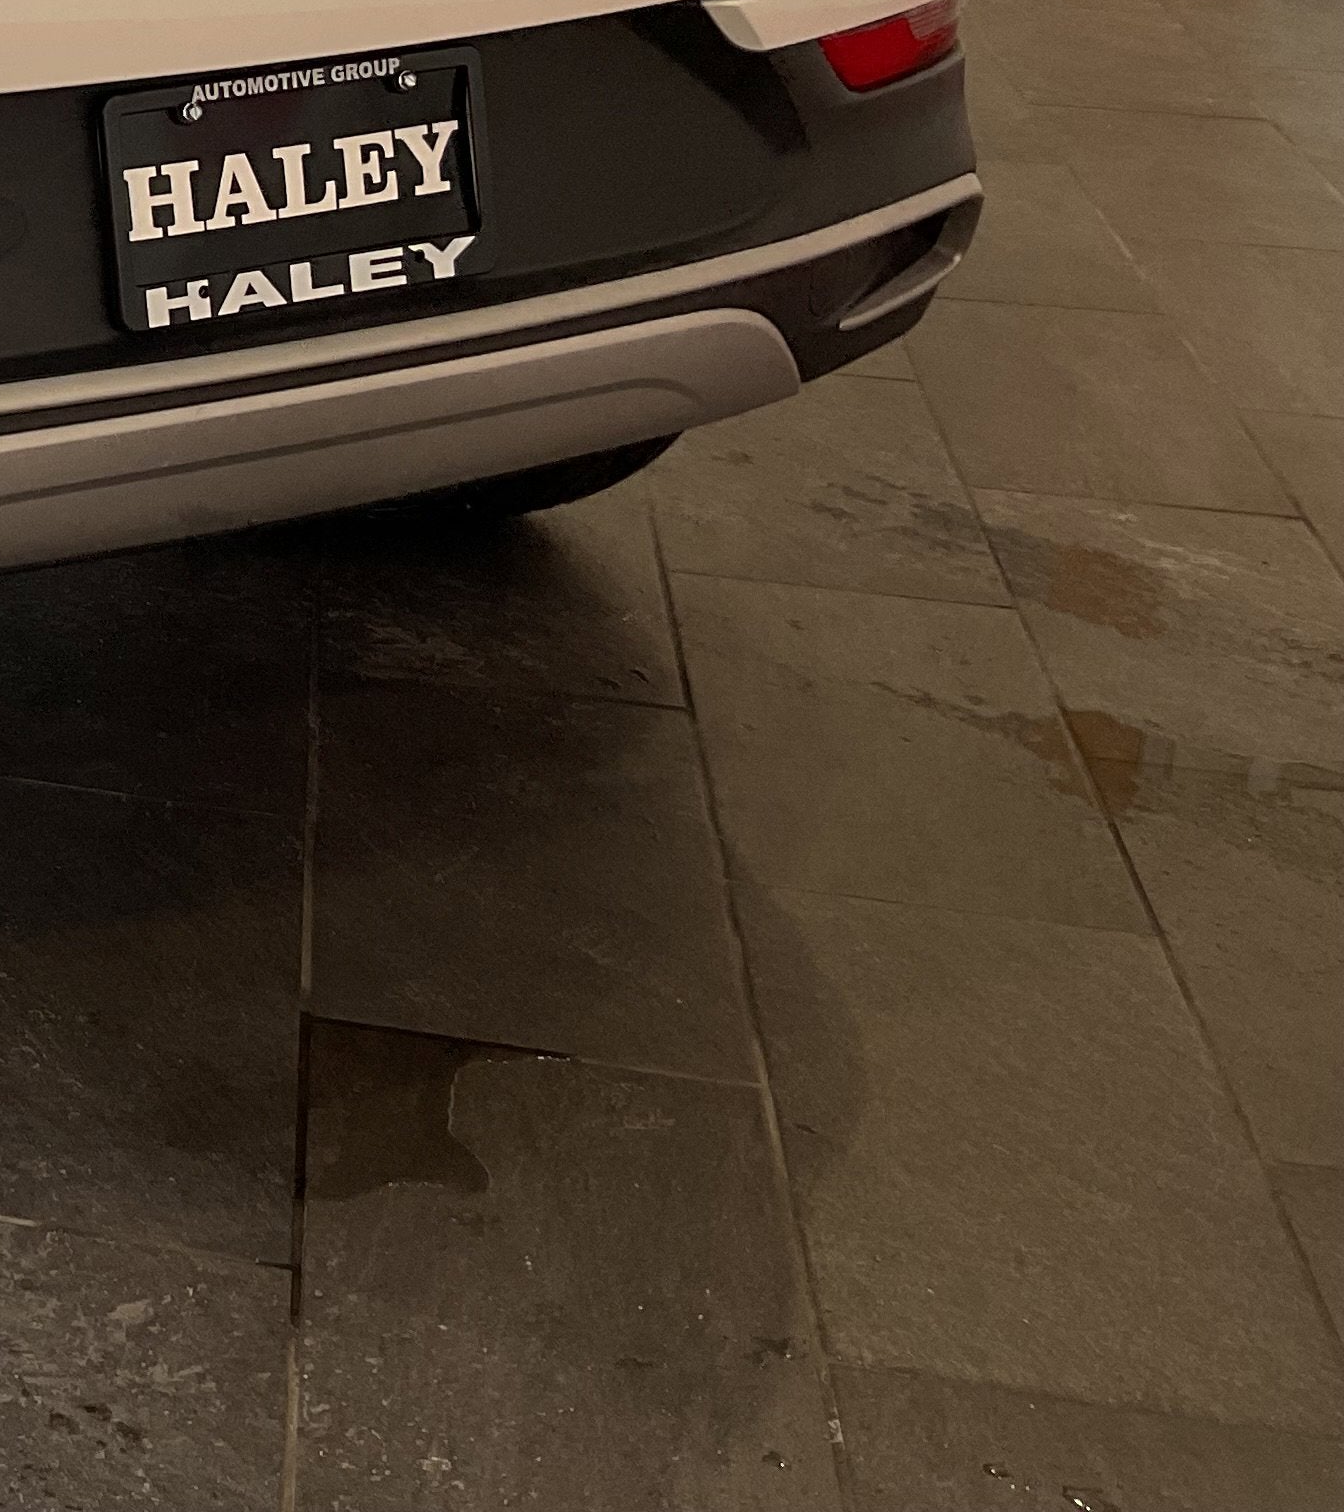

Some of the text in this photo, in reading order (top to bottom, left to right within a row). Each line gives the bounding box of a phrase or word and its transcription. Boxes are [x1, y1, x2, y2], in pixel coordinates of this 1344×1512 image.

[191, 57, 401, 103] AUTOMOTIVE GROUP
[123, 119, 459, 242] HALEY
[145, 235, 476, 329] HALEY
